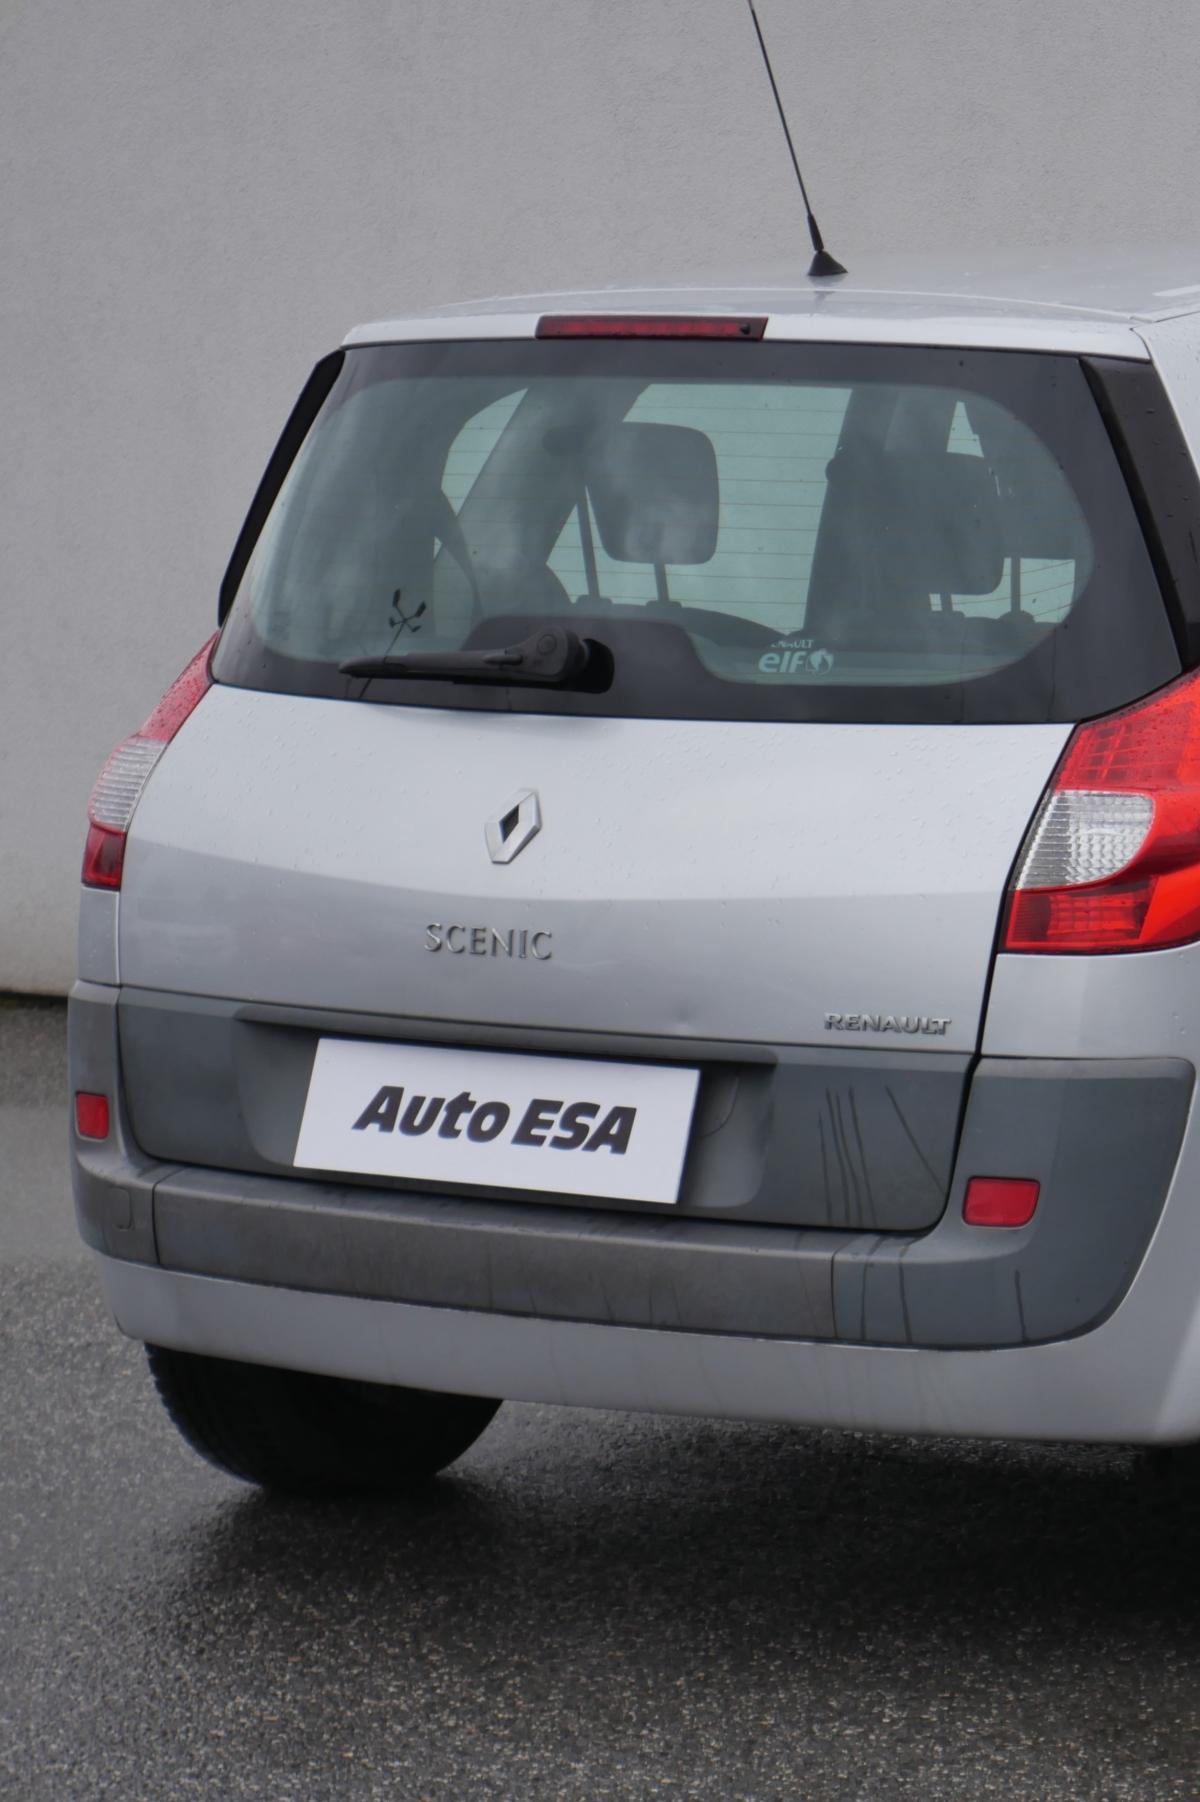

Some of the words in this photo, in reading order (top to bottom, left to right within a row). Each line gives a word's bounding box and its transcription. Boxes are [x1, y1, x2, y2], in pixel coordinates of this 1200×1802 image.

[758, 651, 807, 673] elf
[424, 922, 553, 961] SCENIC
[823, 1012, 951, 1036] RENAULT
[353, 1084, 511, 1144] Auto
[511, 1097, 638, 1155] ESA
